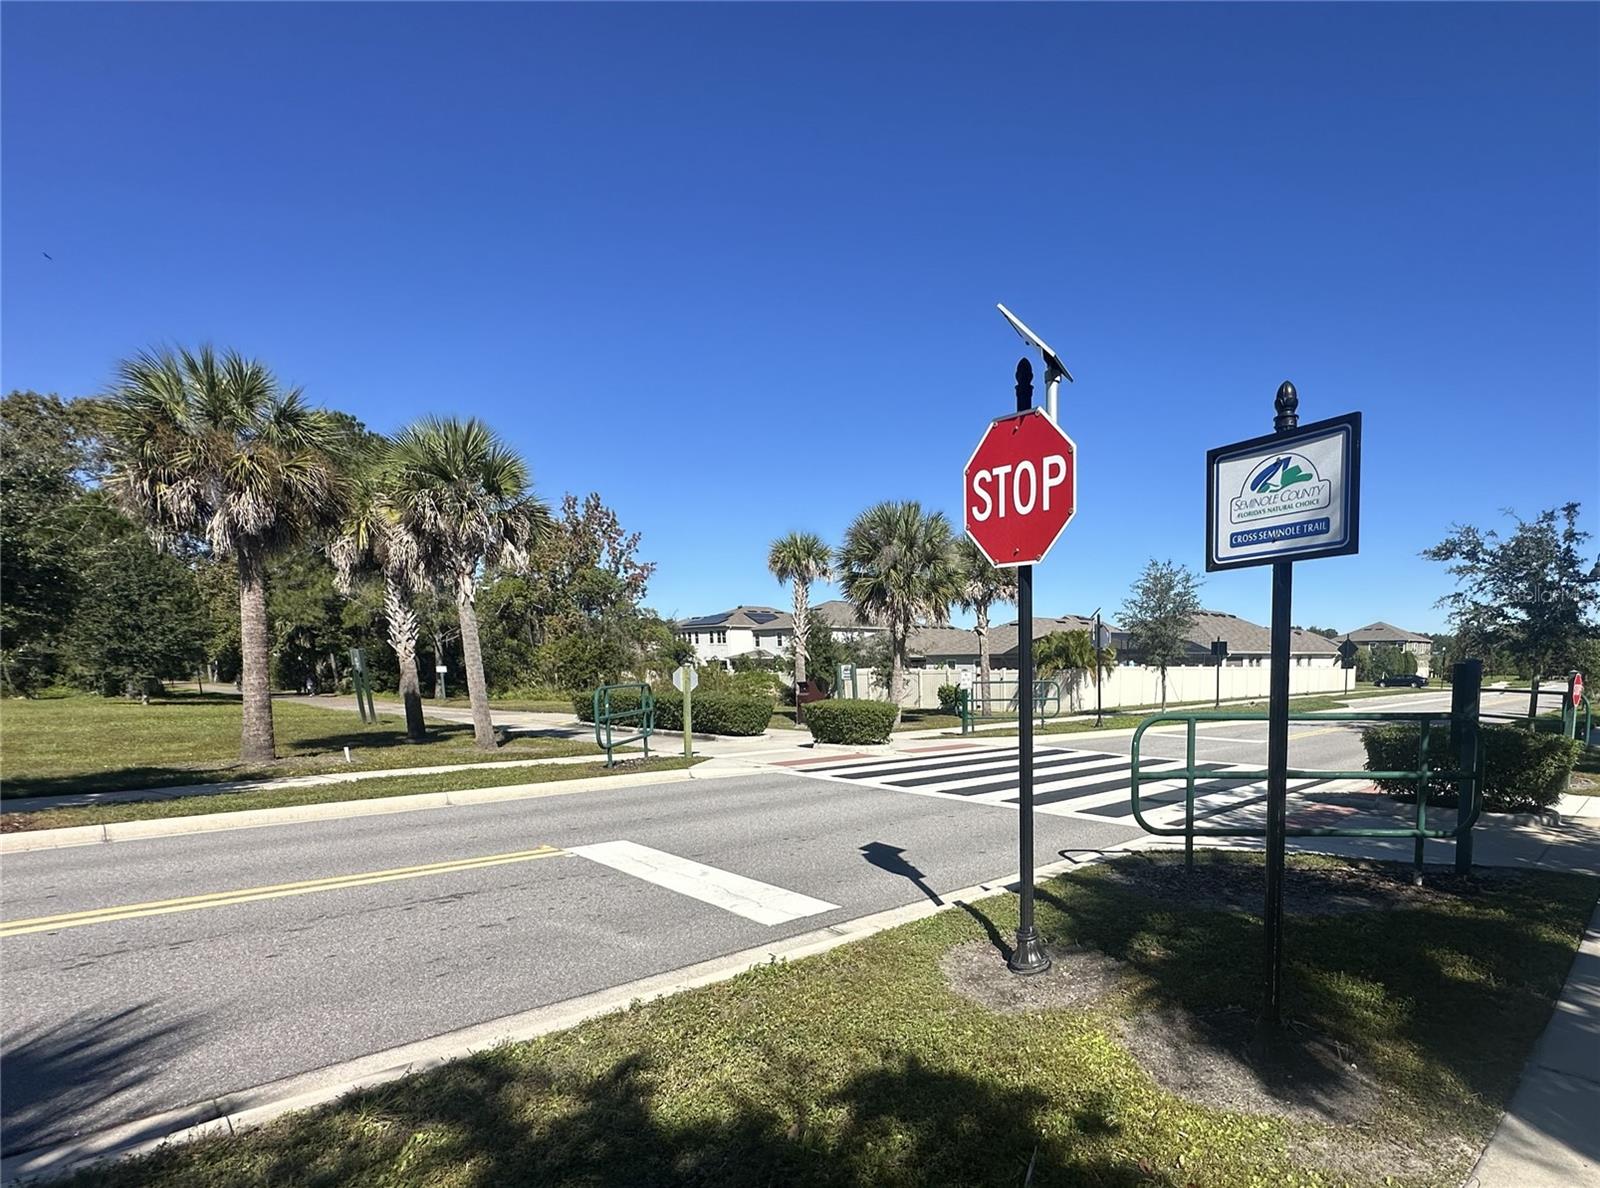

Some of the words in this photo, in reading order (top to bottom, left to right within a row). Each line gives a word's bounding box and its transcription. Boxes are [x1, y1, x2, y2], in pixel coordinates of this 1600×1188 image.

[971, 454, 1067, 522] STOP
[1234, 494, 1279, 512] SEMINOLE
[1280, 485, 1325, 503] COUNTY
[1237, 508, 1266, 519] FLORIDA'S
[1267, 503, 1294, 514] NATURAL
[1295, 499, 1320, 509] CHOICE
[1231, 532, 1257, 544] CROSS
[1258, 526, 1301, 540] SEMINOLE
[1303, 521, 1327, 533] TRAIL
